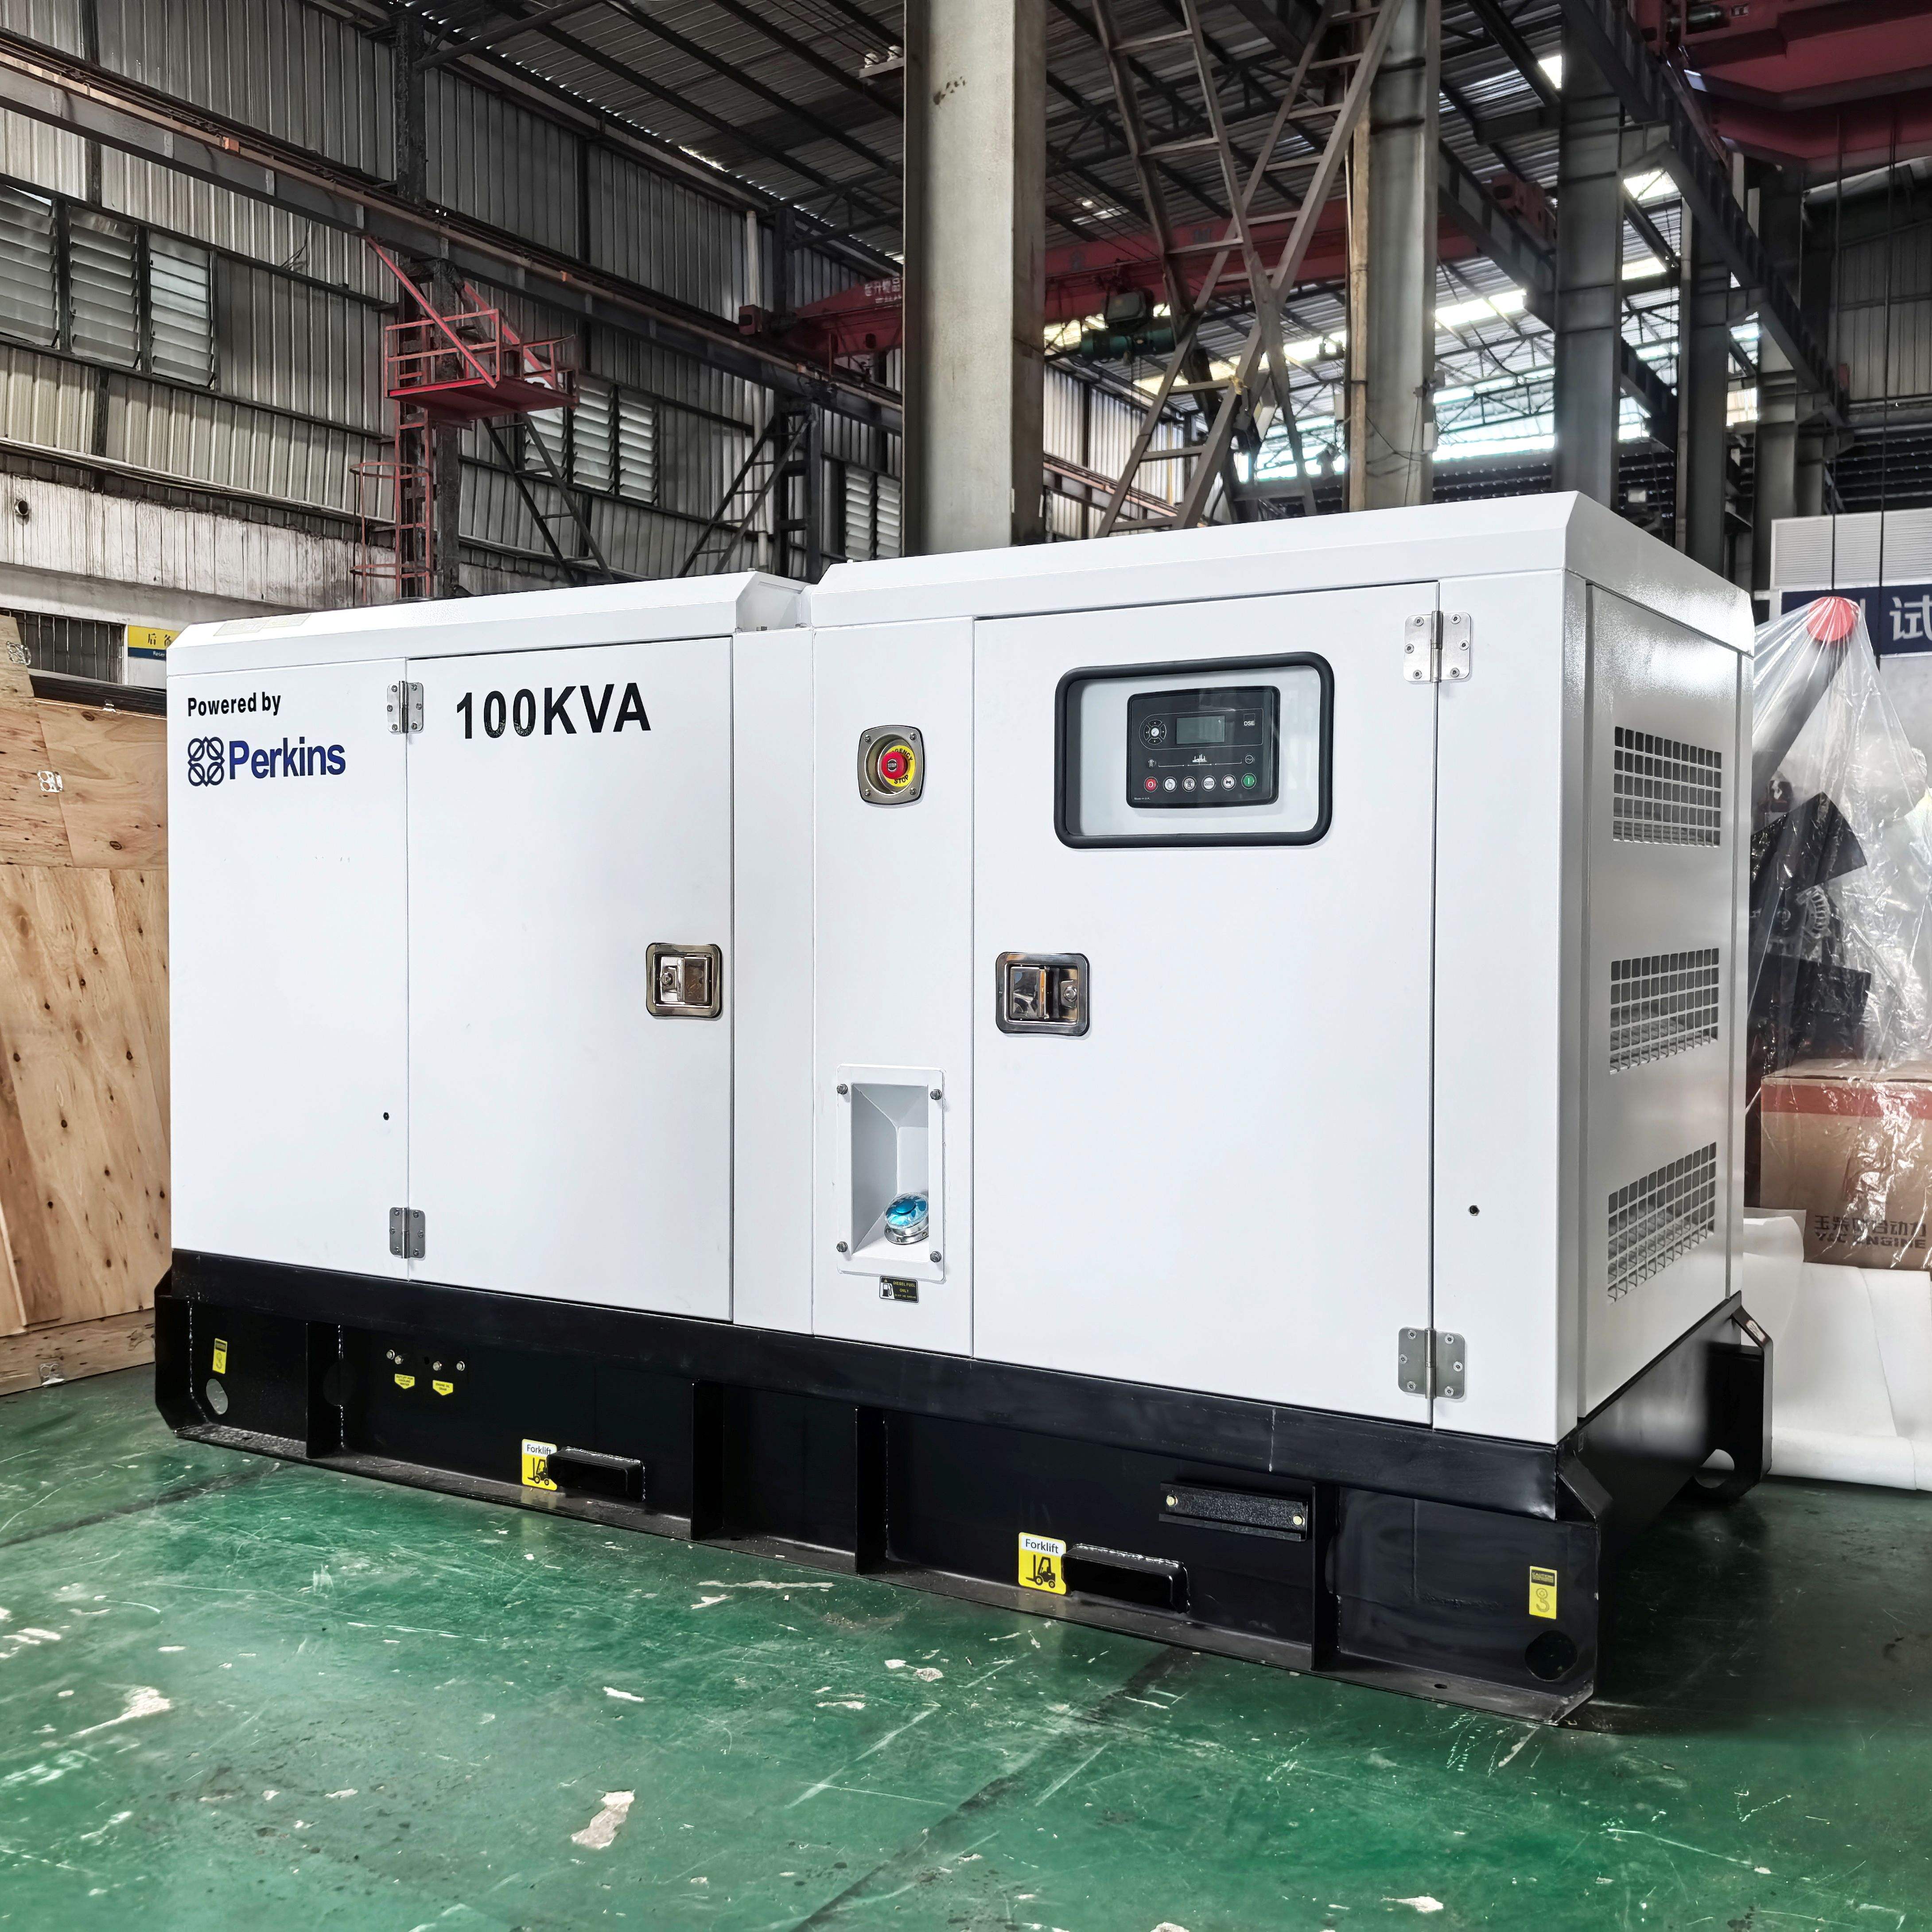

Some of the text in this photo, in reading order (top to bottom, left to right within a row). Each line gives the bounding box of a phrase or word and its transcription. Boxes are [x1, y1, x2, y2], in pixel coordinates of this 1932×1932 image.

[188, 692, 280, 716] Powered by
[457, 683, 651, 739] 100KVA
[229, 737, 346, 779] Perkins
[892, 748, 913, 761] GENCY
[894, 774, 909, 784] STOP
[527, 1444, 552, 1455] Forklift
[1026, 1539, 1059, 1554] Forklift
